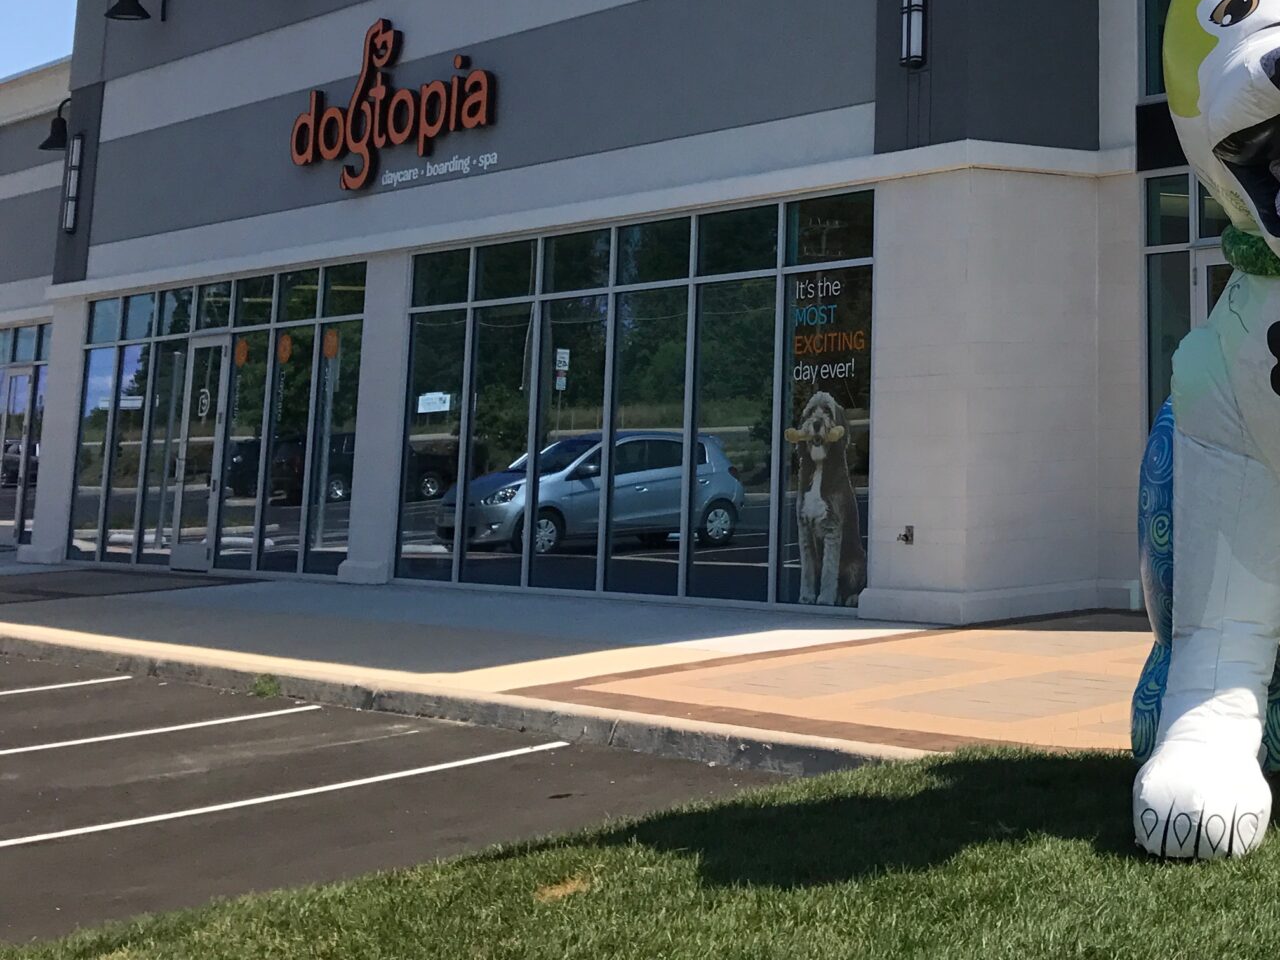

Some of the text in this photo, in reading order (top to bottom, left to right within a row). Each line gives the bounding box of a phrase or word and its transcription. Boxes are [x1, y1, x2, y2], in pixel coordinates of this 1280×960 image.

[291, 18, 492, 190] dogtopia
[381, 152, 498, 187] daycare boarding spa
[796, 277, 841, 300] It's the
[794, 304, 837, 327] MOST
[794, 330, 865, 355] EXCITING
[793, 358, 855, 385] day ever!
